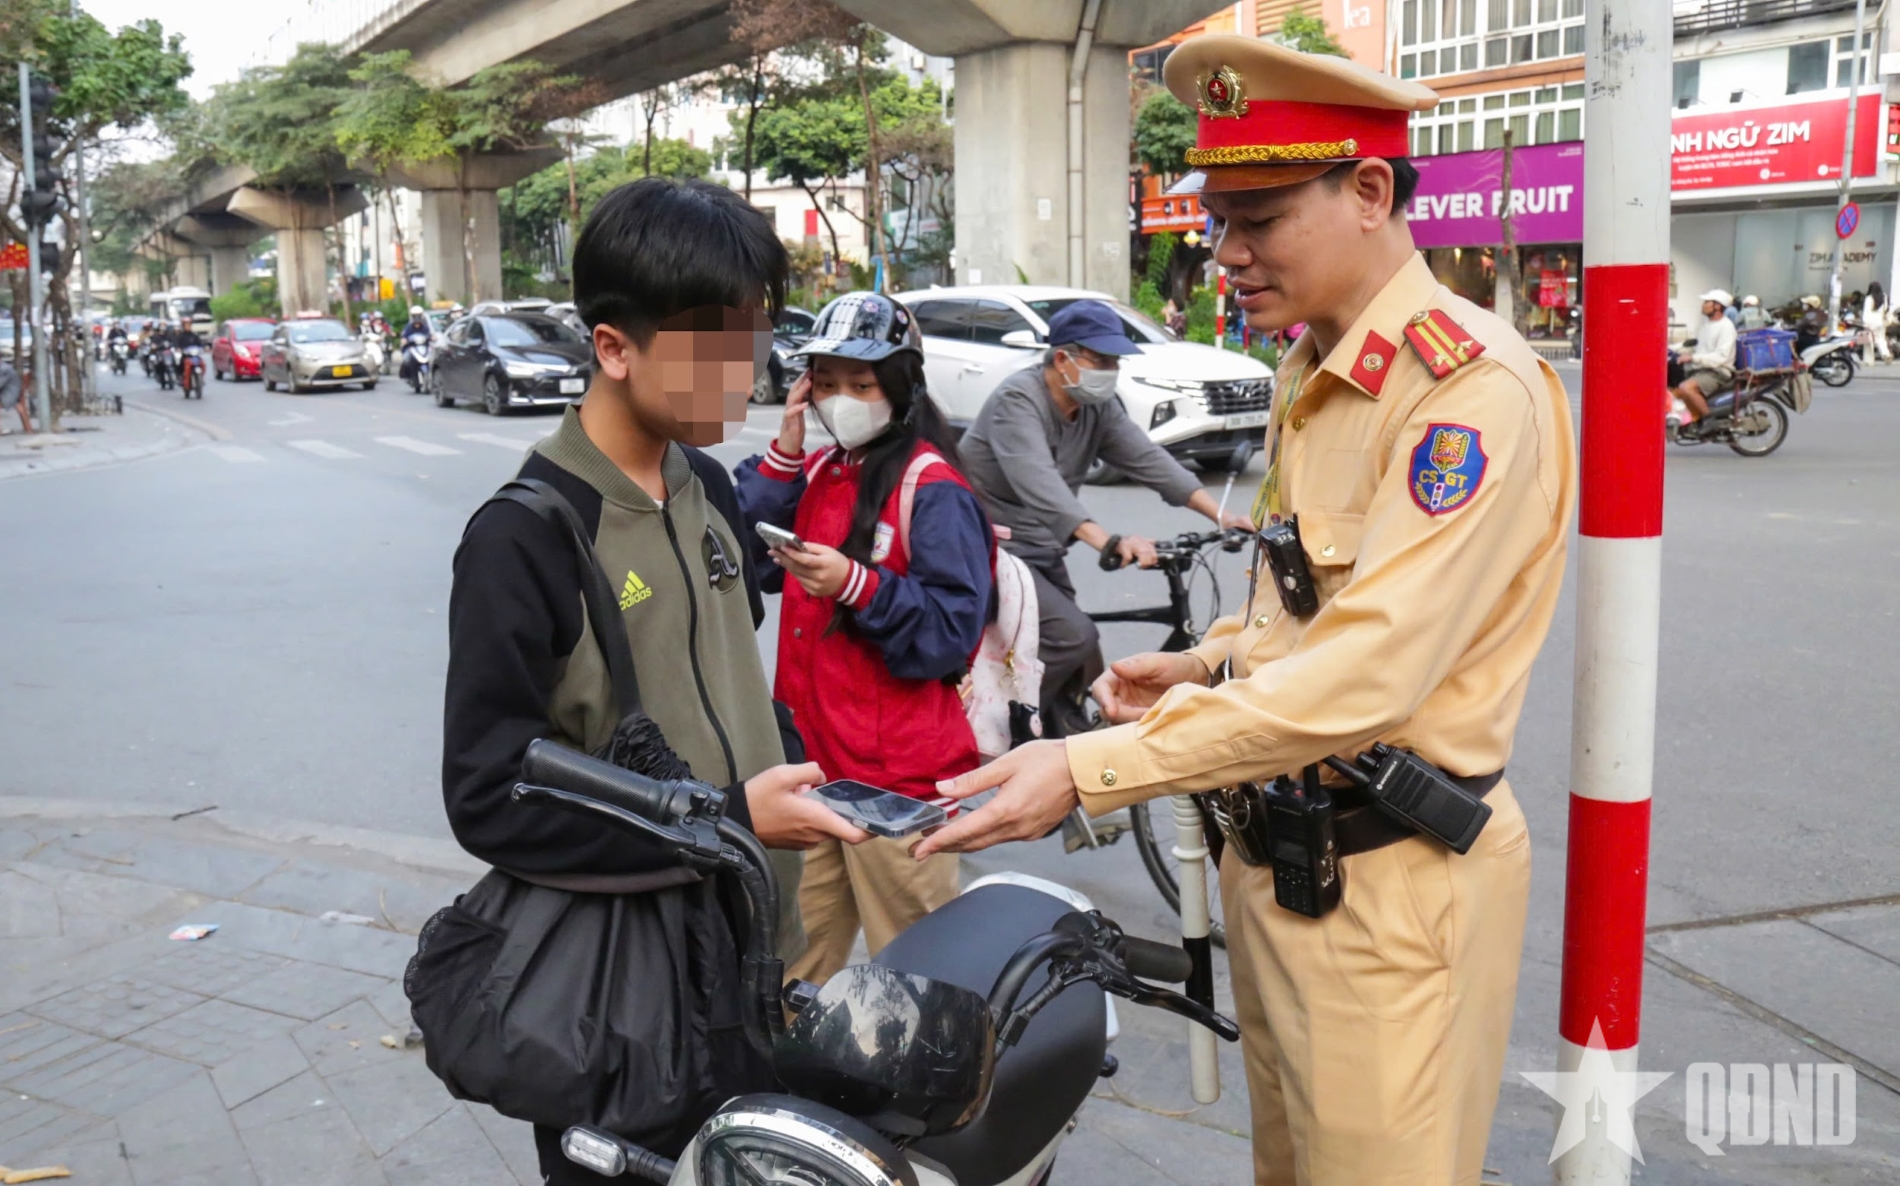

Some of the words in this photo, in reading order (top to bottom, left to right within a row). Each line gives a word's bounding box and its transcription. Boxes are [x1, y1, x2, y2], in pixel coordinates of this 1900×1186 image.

[1707, 121, 1761, 150] NGỮ
[1767, 120, 1811, 146] ZIM
[1492, 185, 1574, 217] FRUIT
[618, 587, 653, 611] adidas
